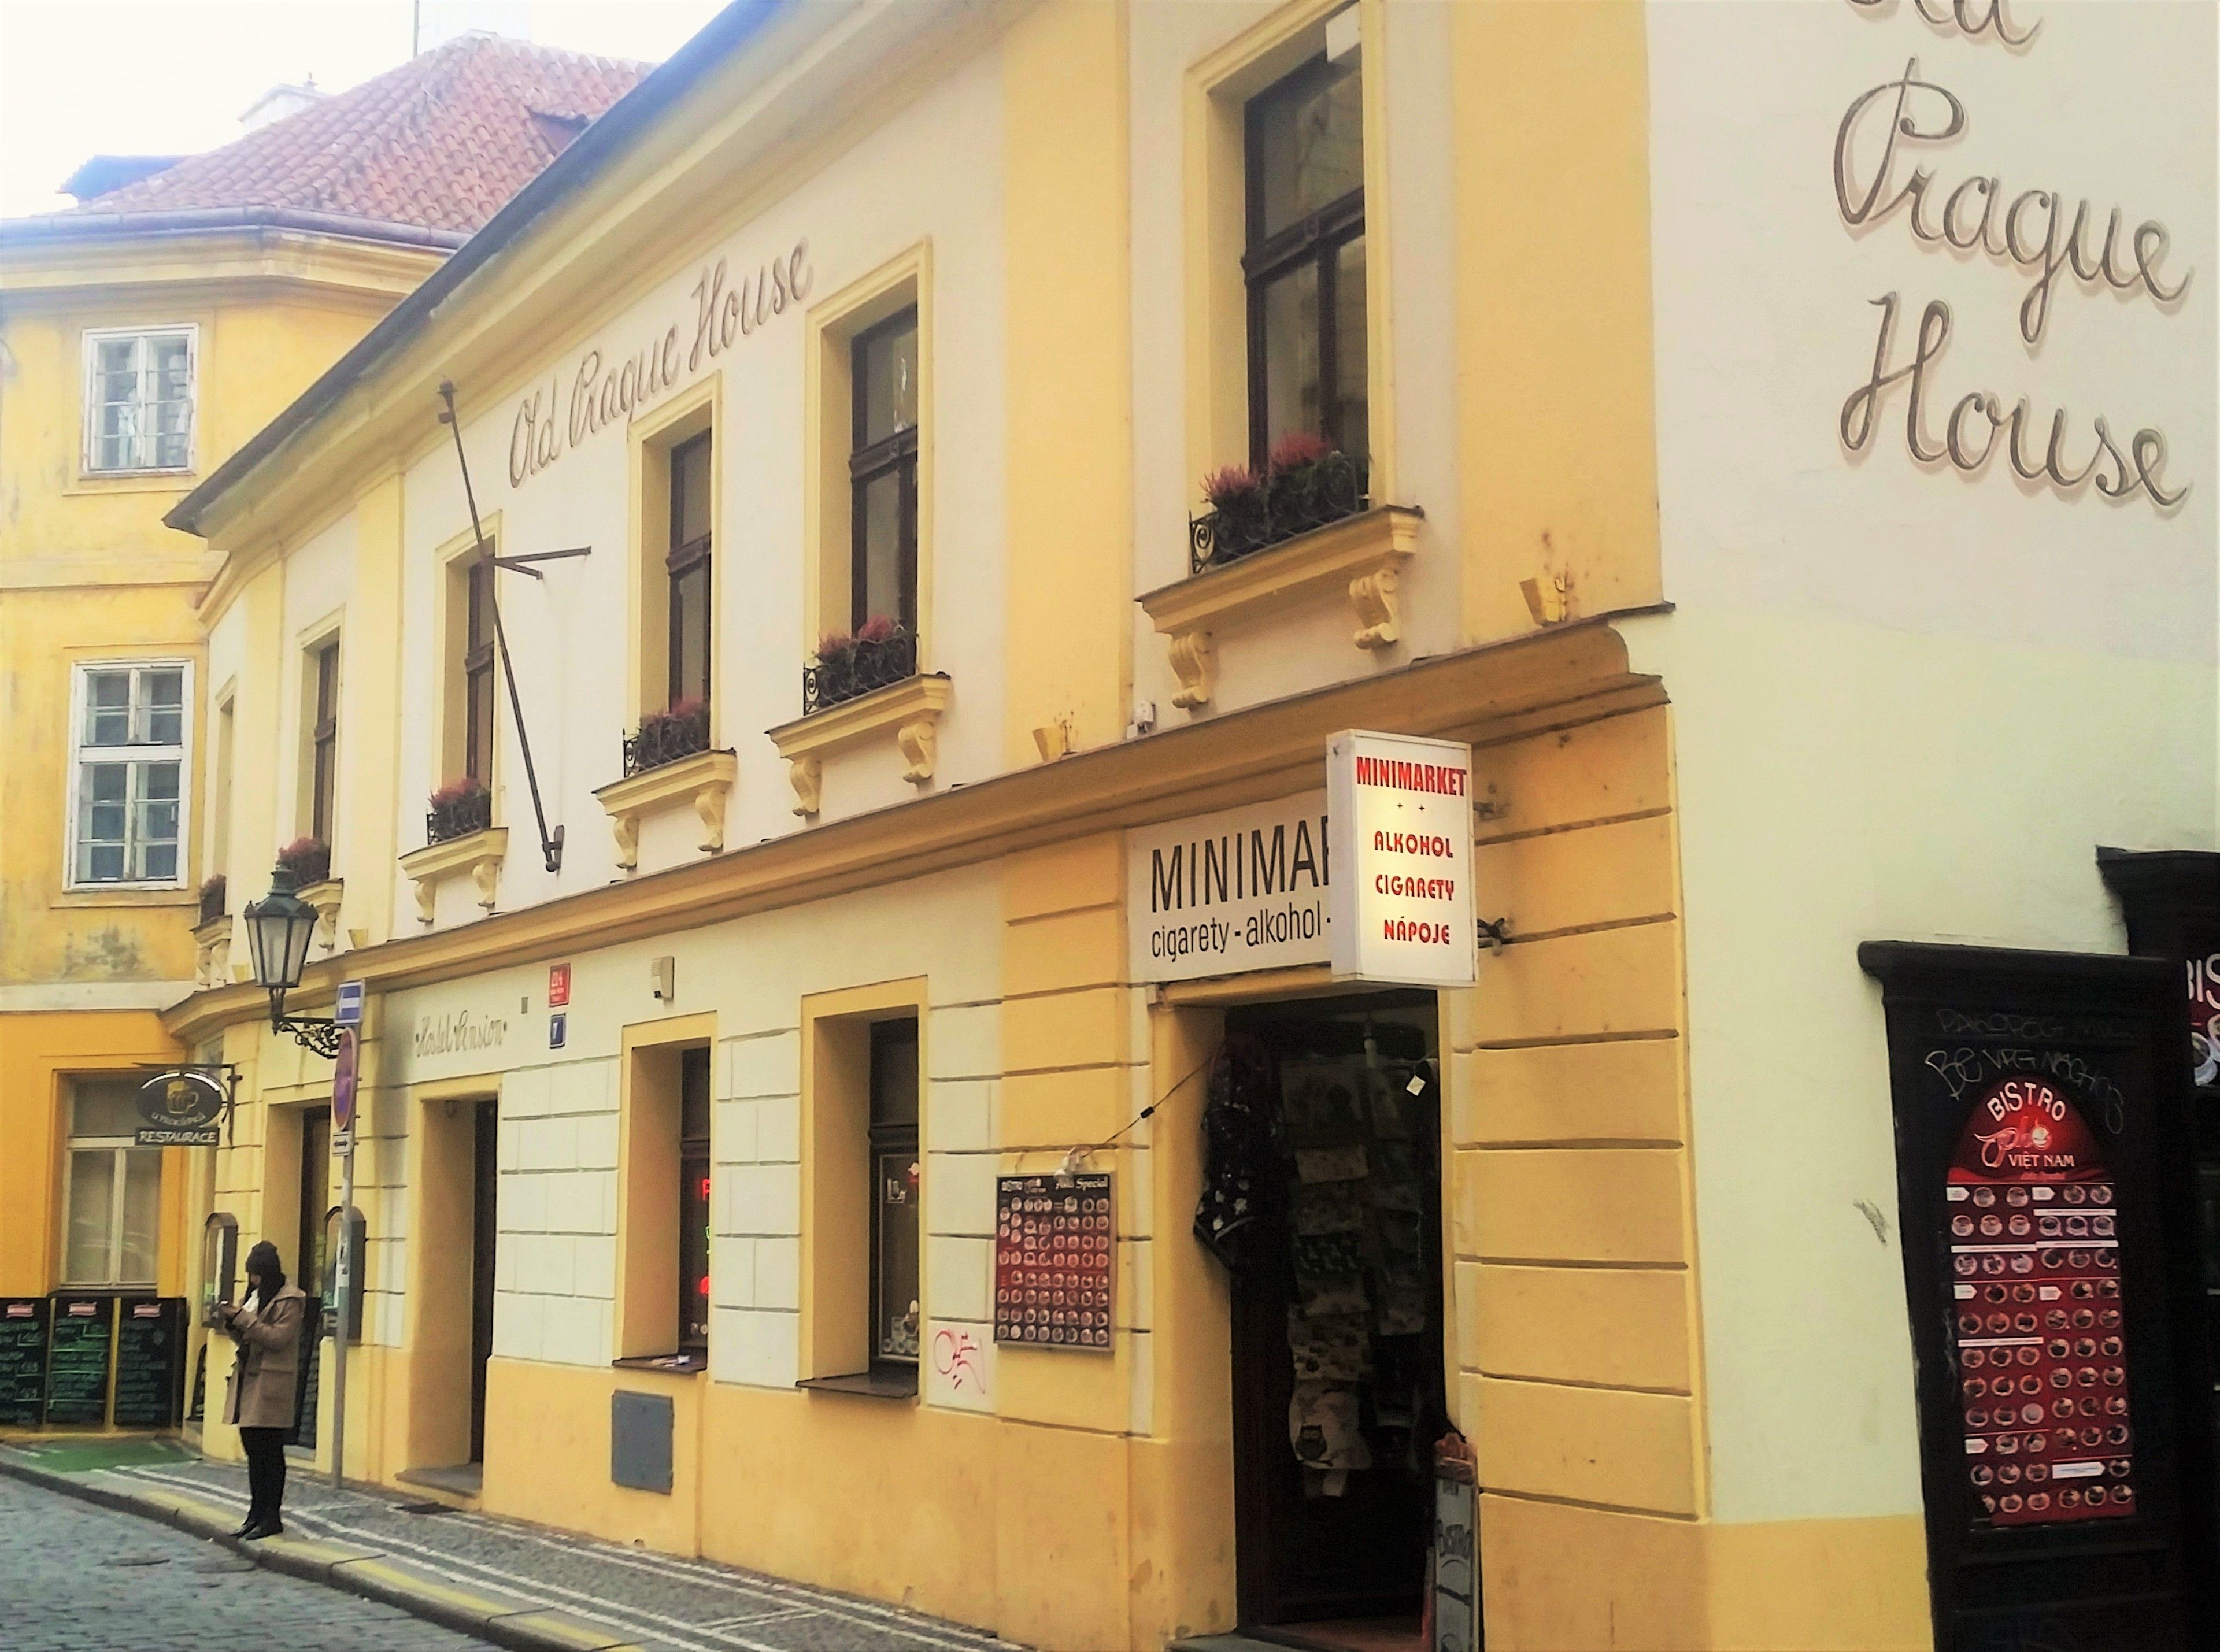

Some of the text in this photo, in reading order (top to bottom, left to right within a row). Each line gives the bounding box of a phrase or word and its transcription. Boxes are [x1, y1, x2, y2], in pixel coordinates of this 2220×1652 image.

[1833, 57, 2190, 344] Prague
[509, 242, 812, 488] Old Prague House
[1840, 291, 2188, 506] House
[1356, 756, 1467, 797] MINIMARKET
[1374, 831, 1453, 858] ALKOHOL
[1375, 874, 1455, 901] CIGARETY
[1152, 917, 1230, 962] cigarety
[1246, 900, 1321, 947] alkohol
[1384, 916, 1450, 945] NÁPOJE
[1987, 1081, 2066, 1122] BISTRO
[139, 1130, 217, 1143] RESTAURACE
[2044, 1154, 2075, 1168] NAM
